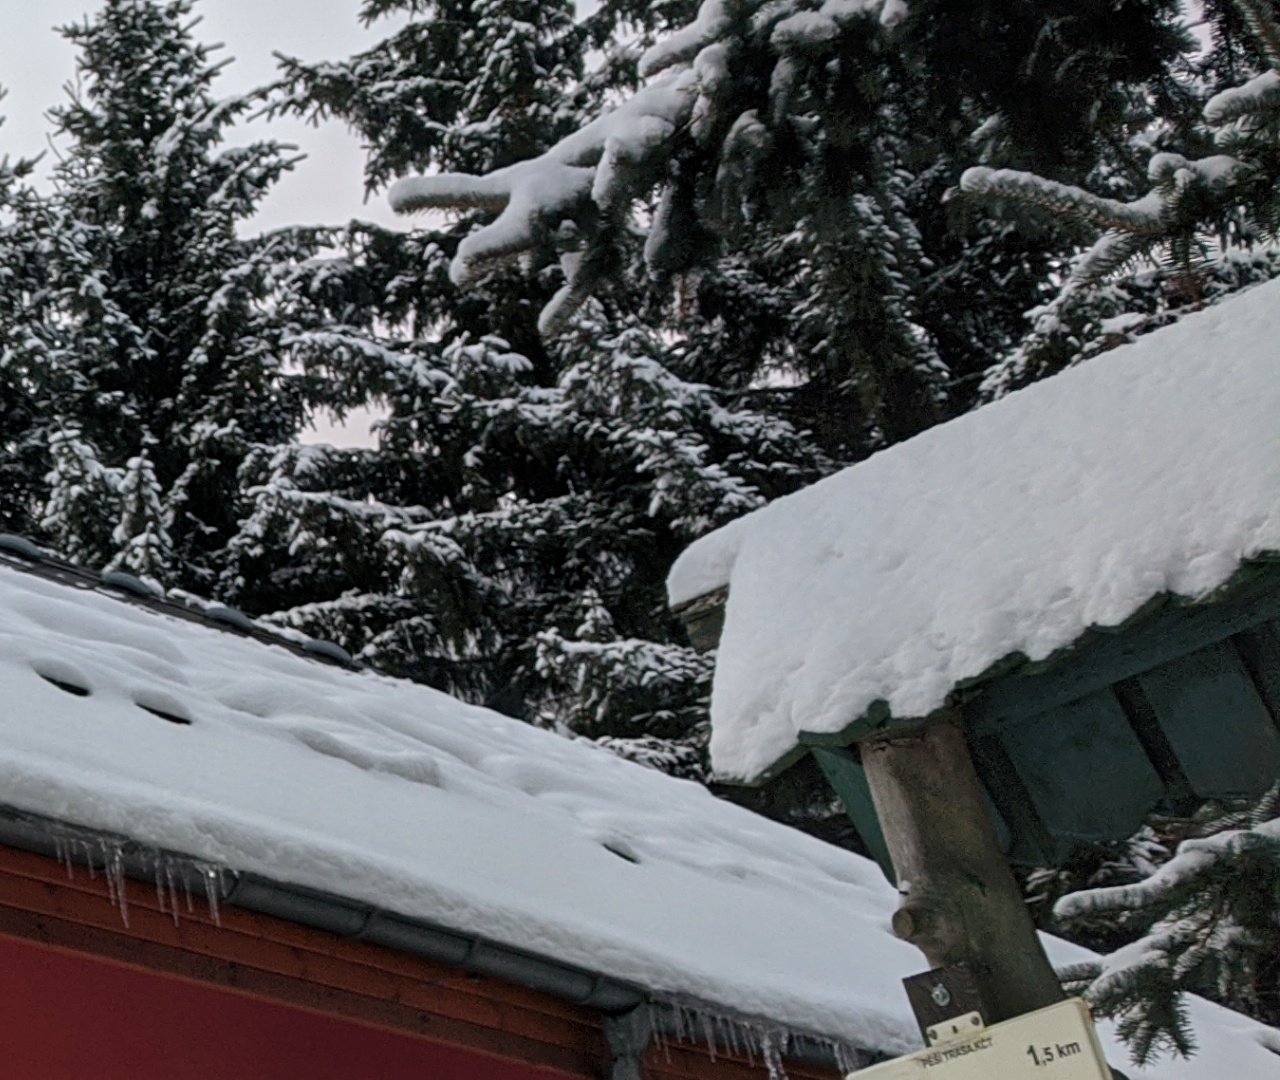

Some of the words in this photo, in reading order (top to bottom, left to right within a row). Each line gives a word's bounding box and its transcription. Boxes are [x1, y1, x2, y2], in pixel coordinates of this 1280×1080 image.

[943, 1046, 971, 1062] TRASA
[1027, 1044, 1054, 1066] 1,5
[1056, 1041, 1081, 1058] km
